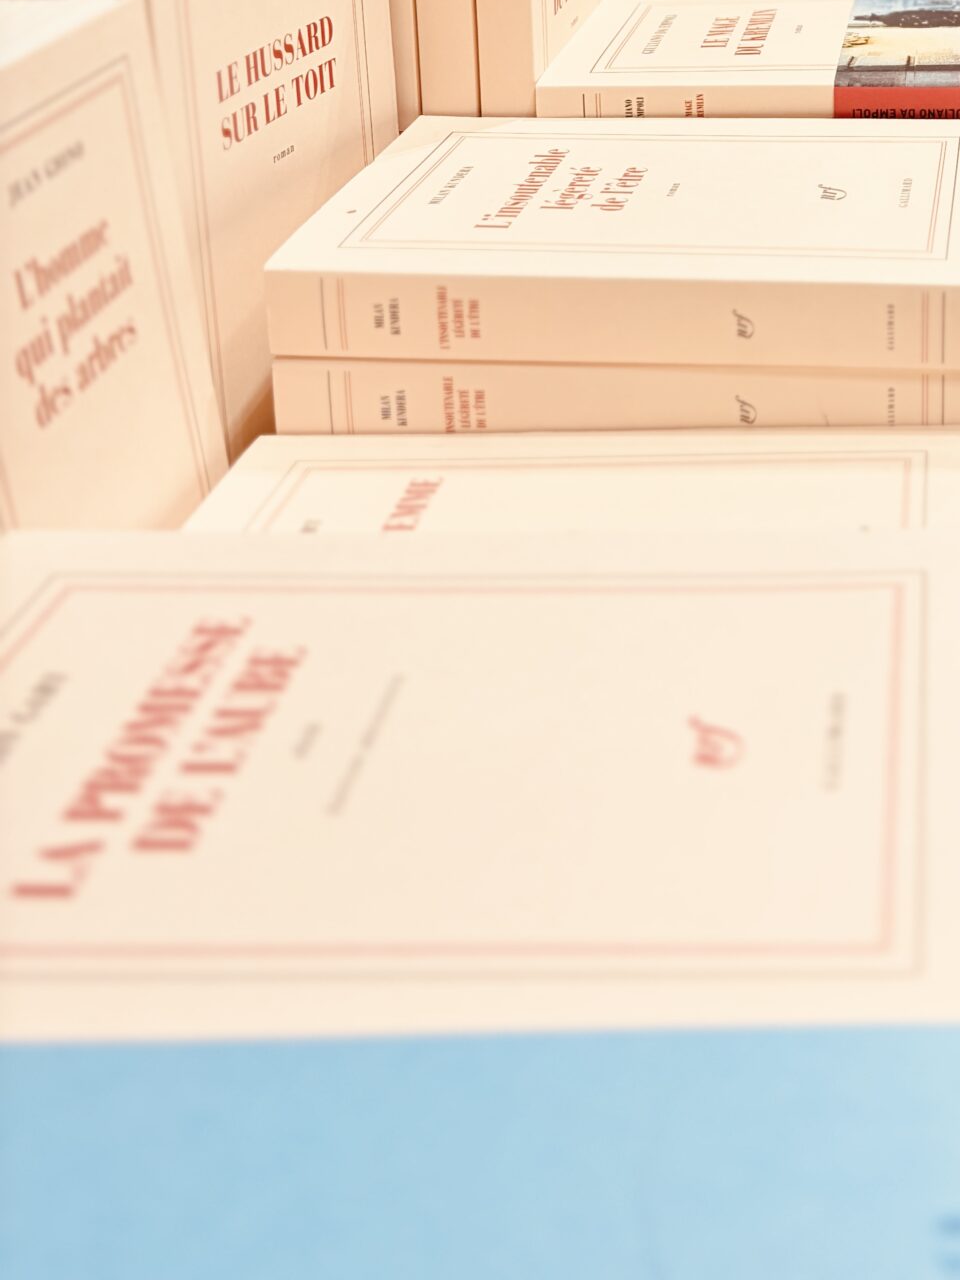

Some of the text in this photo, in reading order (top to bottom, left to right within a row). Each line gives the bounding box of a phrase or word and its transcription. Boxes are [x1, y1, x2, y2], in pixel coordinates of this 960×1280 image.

[700, 16, 741, 48] LE MAGE
[734, 8, 778, 56] DU KREMLIN
[215, 15, 334, 104] LE HUSSARD
[221, 57, 337, 151] SUR LE TOIT
[625, 99, 633, 118] LIANO
[636, 96, 645, 118] MPOLI
[696, 93, 705, 118] REMLIN
[852, 108, 896, 119] EMPOLI
[900, 108, 916, 119] DA
[273, 145, 295, 164] roman
[473, 148, 570, 229] L'insoutenable
[540, 166, 603, 210] légèreté
[590, 166, 649, 212] de l'être
[818, 184, 847, 201] nrf
[899, 177, 913, 208] GALLIMARD
[13, 218, 110, 311] L'homme
[14, 253, 134, 387] qui plantait
[732, 308, 755, 340] nrf
[35, 318, 138, 430] des arbres
[734, 394, 757, 425] nrf
[9, 838, 105, 899] LA
[62, 615, 253, 822] PROMESSE
[132, 644, 308, 852] DE L'AUBE
